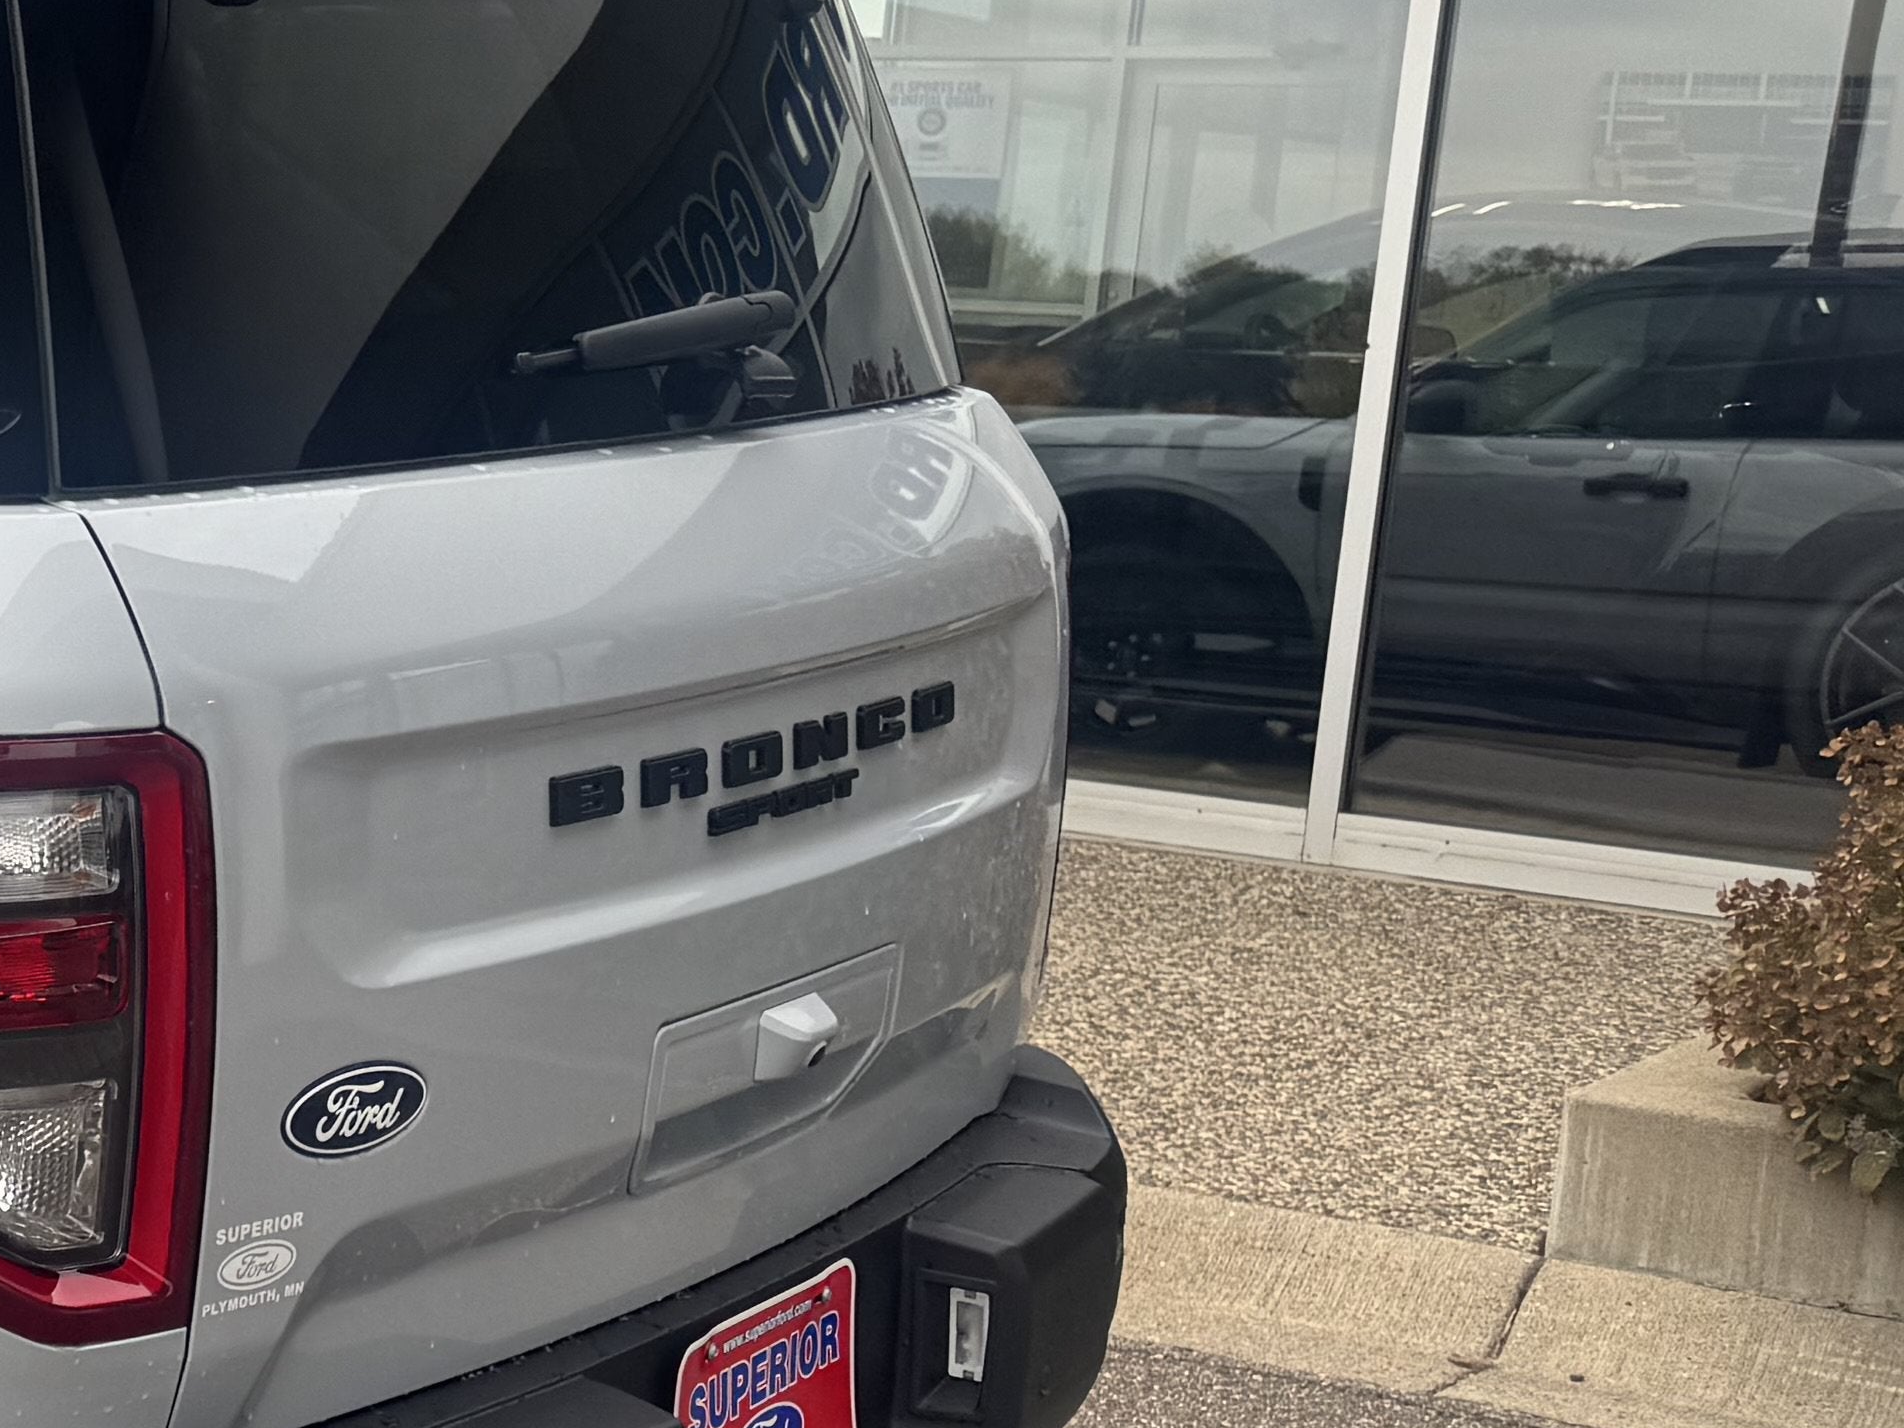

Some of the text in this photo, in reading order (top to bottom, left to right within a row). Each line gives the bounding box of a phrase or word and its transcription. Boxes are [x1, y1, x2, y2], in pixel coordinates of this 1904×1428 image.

[549, 681, 955, 827] BRONCO
[707, 768, 860, 837] SPORT
[316, 1080, 404, 1142] Ford
[216, 1212, 304, 1245] SUPERIOR
[237, 1251, 279, 1279] Ford
[202, 1282, 304, 1317] PLYMOUTH, MN
